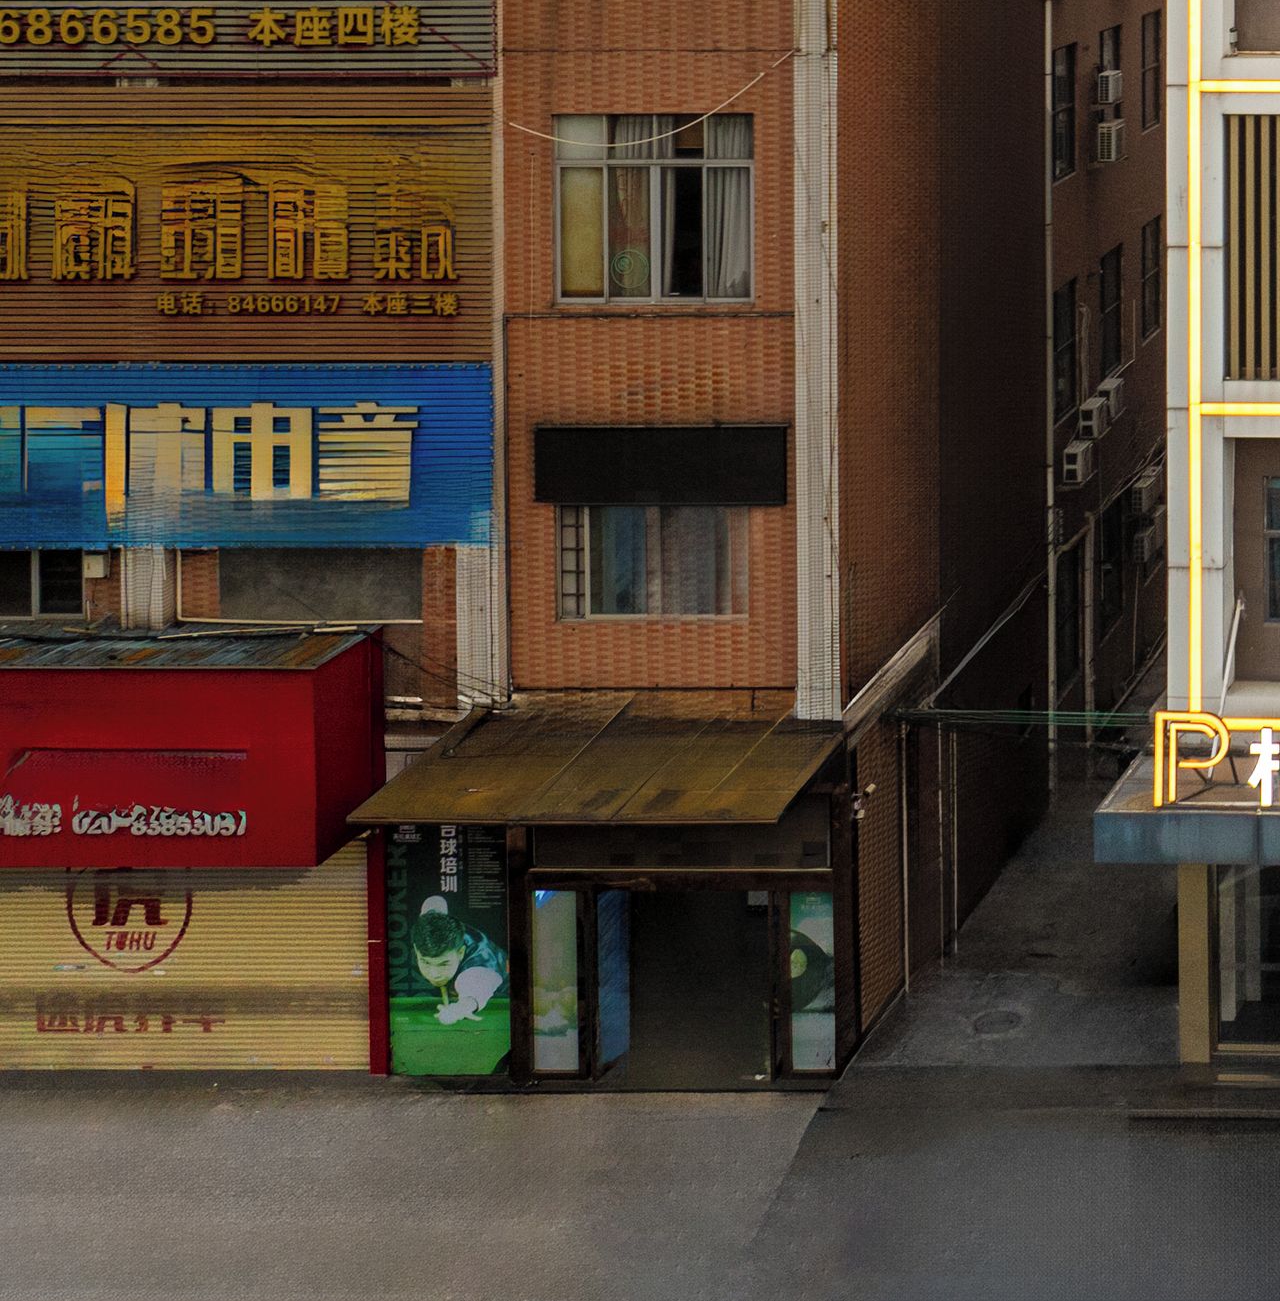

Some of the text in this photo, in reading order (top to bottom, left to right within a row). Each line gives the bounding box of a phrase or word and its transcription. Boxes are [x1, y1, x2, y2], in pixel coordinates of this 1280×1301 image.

[0, 6, 421, 47] 6866585 本座四楼
[362, 291, 460, 317] 本座三楼
